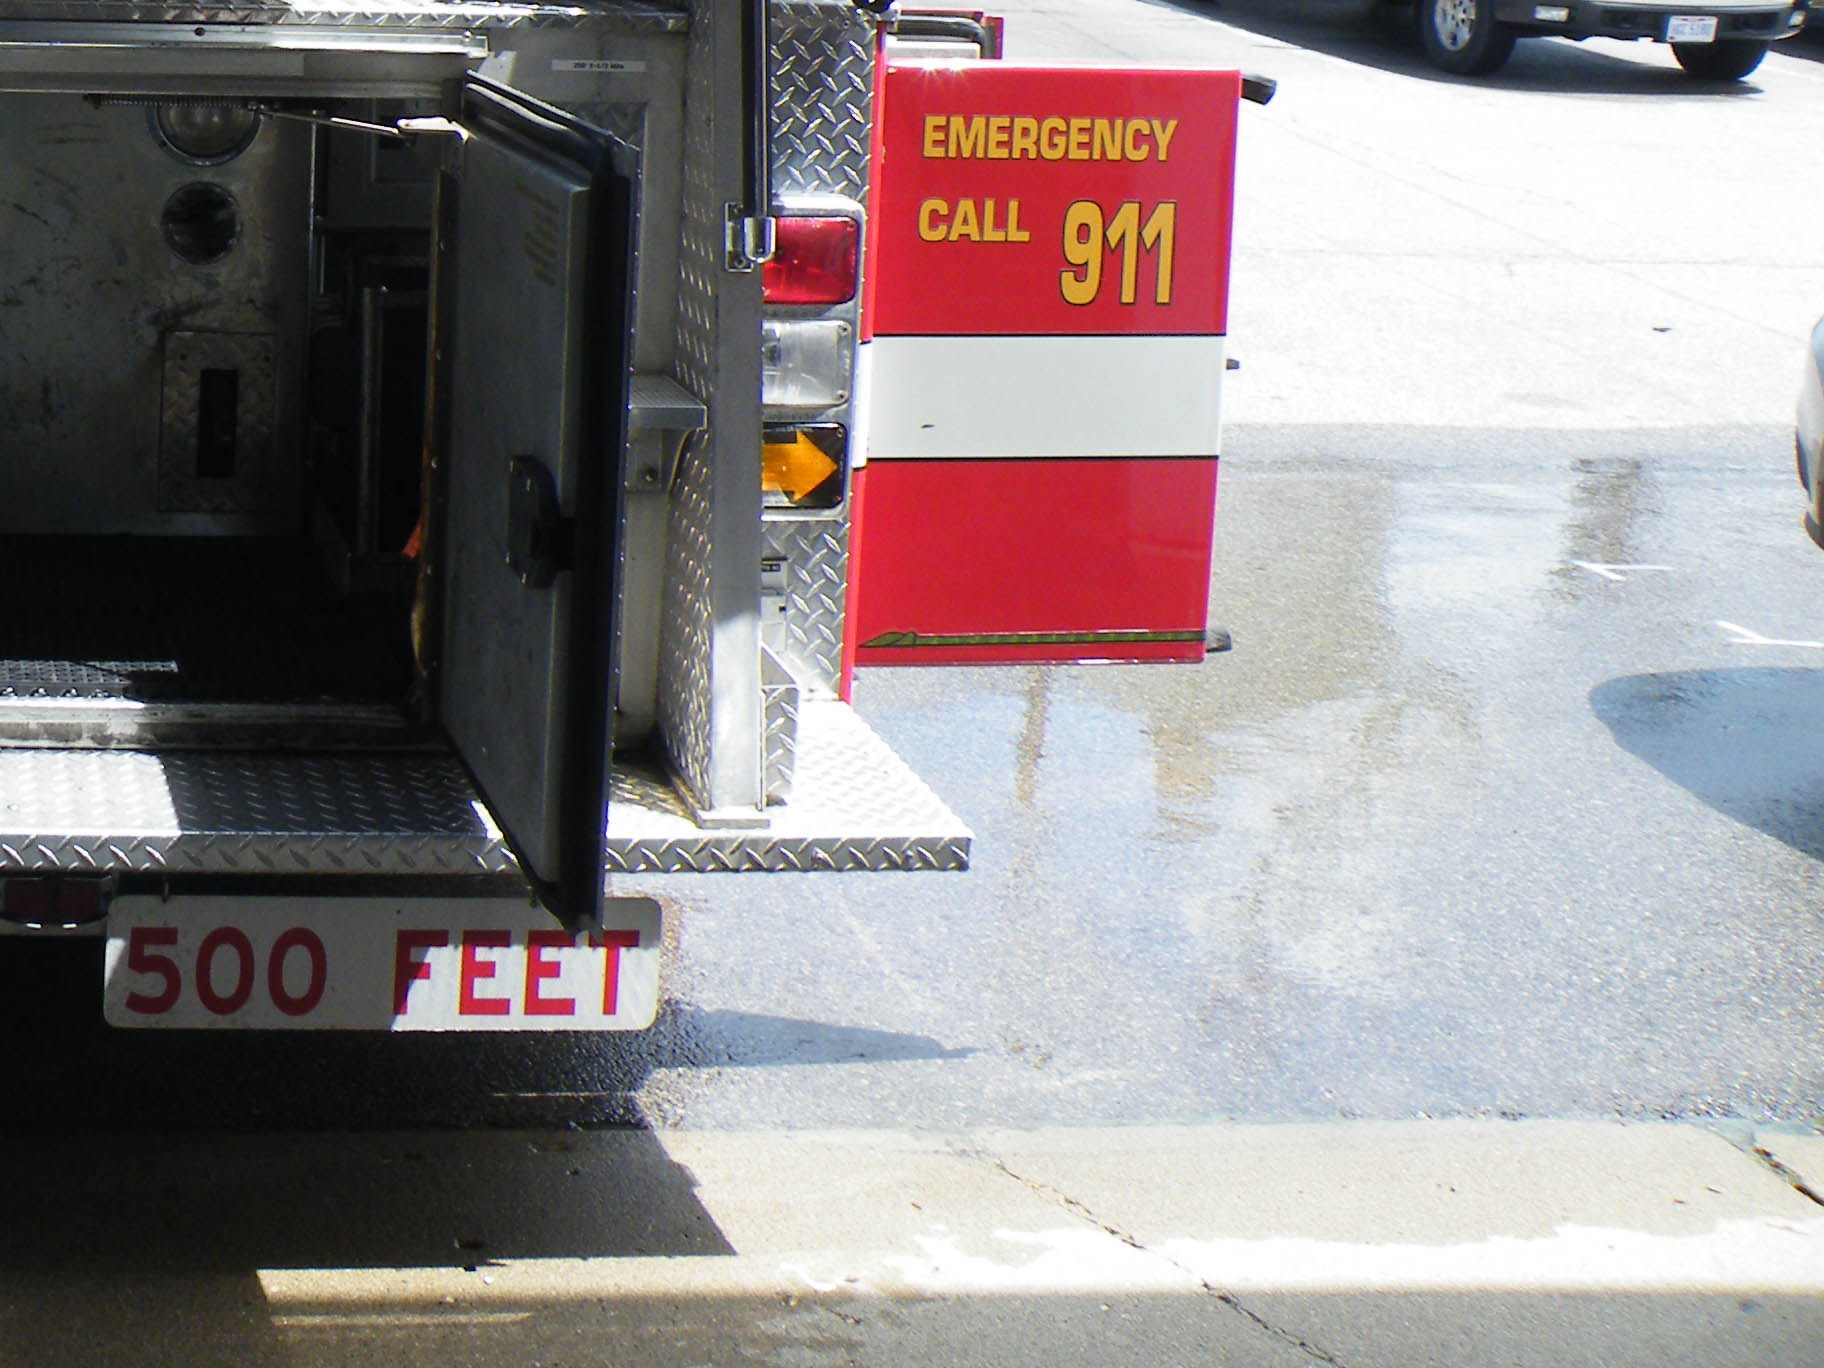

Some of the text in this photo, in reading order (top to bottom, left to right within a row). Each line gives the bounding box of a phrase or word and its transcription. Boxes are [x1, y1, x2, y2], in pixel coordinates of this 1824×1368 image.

[922, 115, 1178, 162] EMERGENCY
[918, 198, 1177, 305] CALL 911
[125, 926, 640, 1016] 500 FEET
